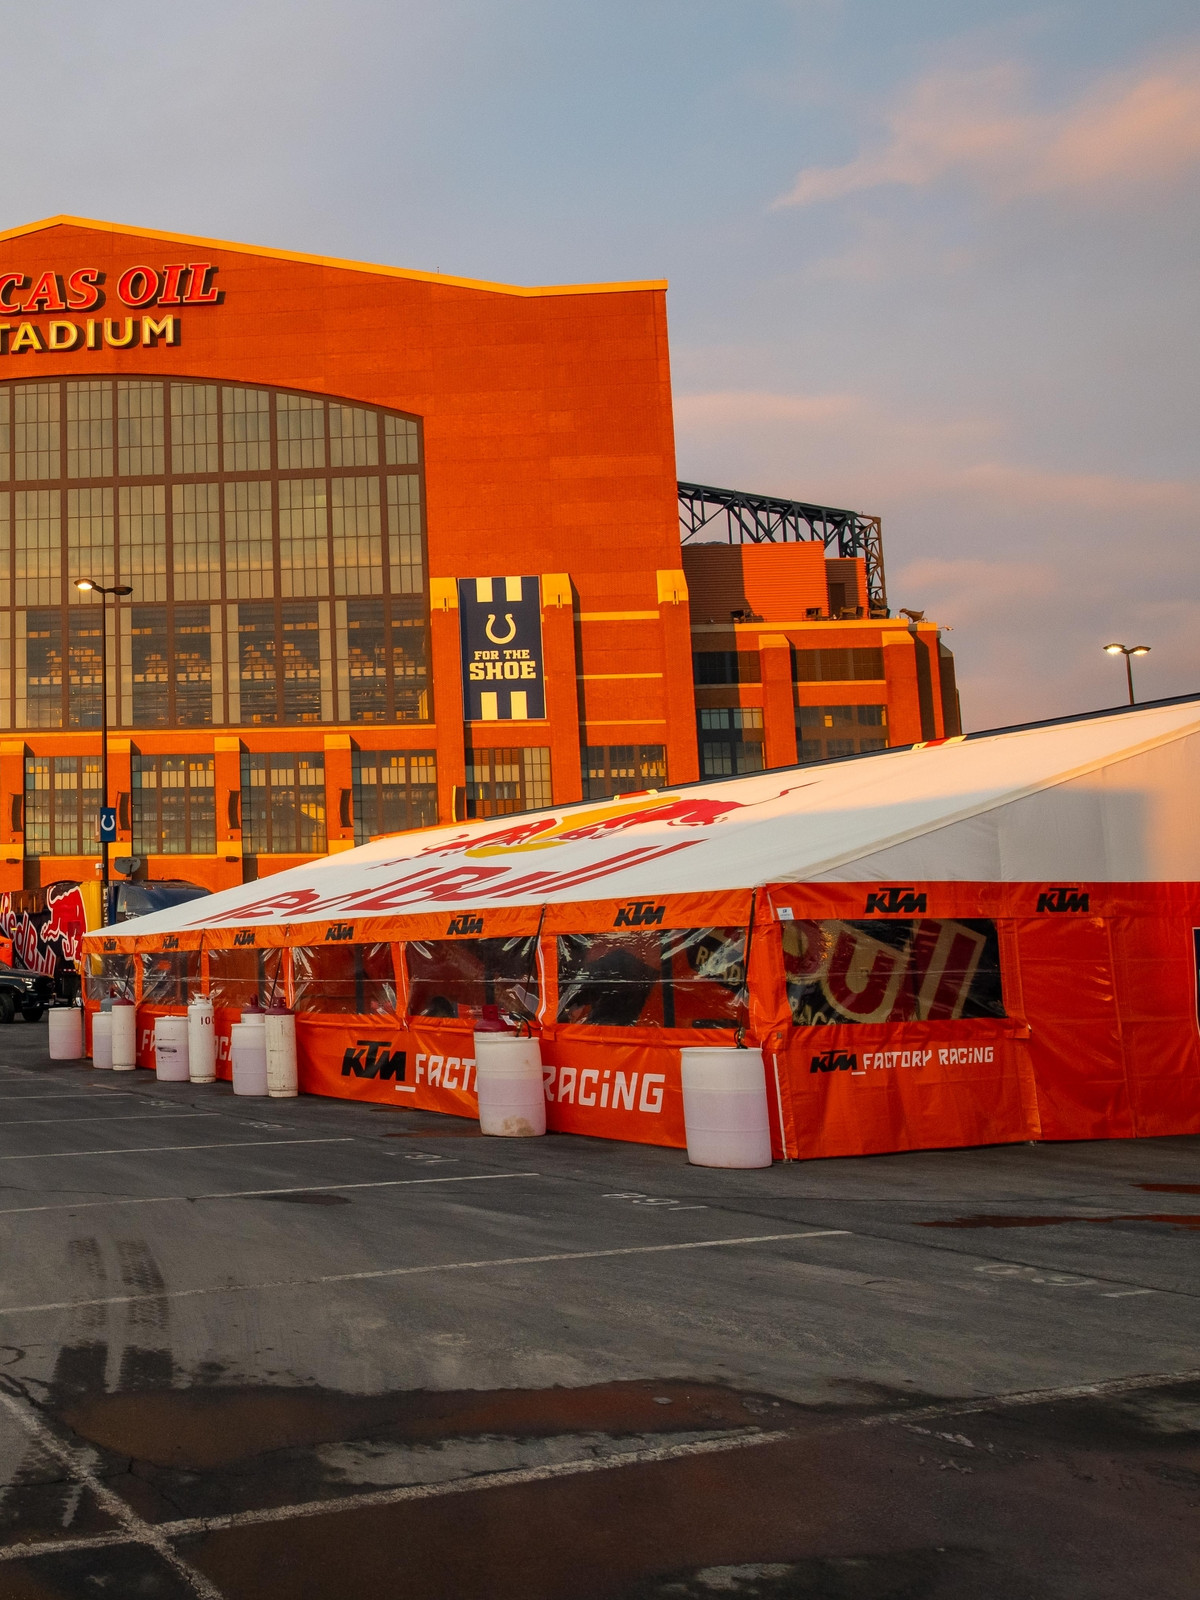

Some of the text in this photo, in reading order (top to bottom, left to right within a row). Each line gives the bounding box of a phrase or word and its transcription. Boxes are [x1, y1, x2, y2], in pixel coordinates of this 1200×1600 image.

[117, 262, 220, 306] OIL
[474, 649, 530, 660] FOR THE
[469, 661, 536, 680] SHOE
[864, 888, 927, 913] KTM
[1036, 888, 1090, 913] KTM
[447, 914, 484, 935] KTM
[613, 901, 666, 927] KTM
[162, 935, 179, 949] KTM
[234, 930, 255, 946] KTM
[325, 923, 354, 941] KTM
[24, 920, 57, 978] Bull
[341, 1040, 406, 1081] KTM
[810, 1050, 857, 1073] KTM
